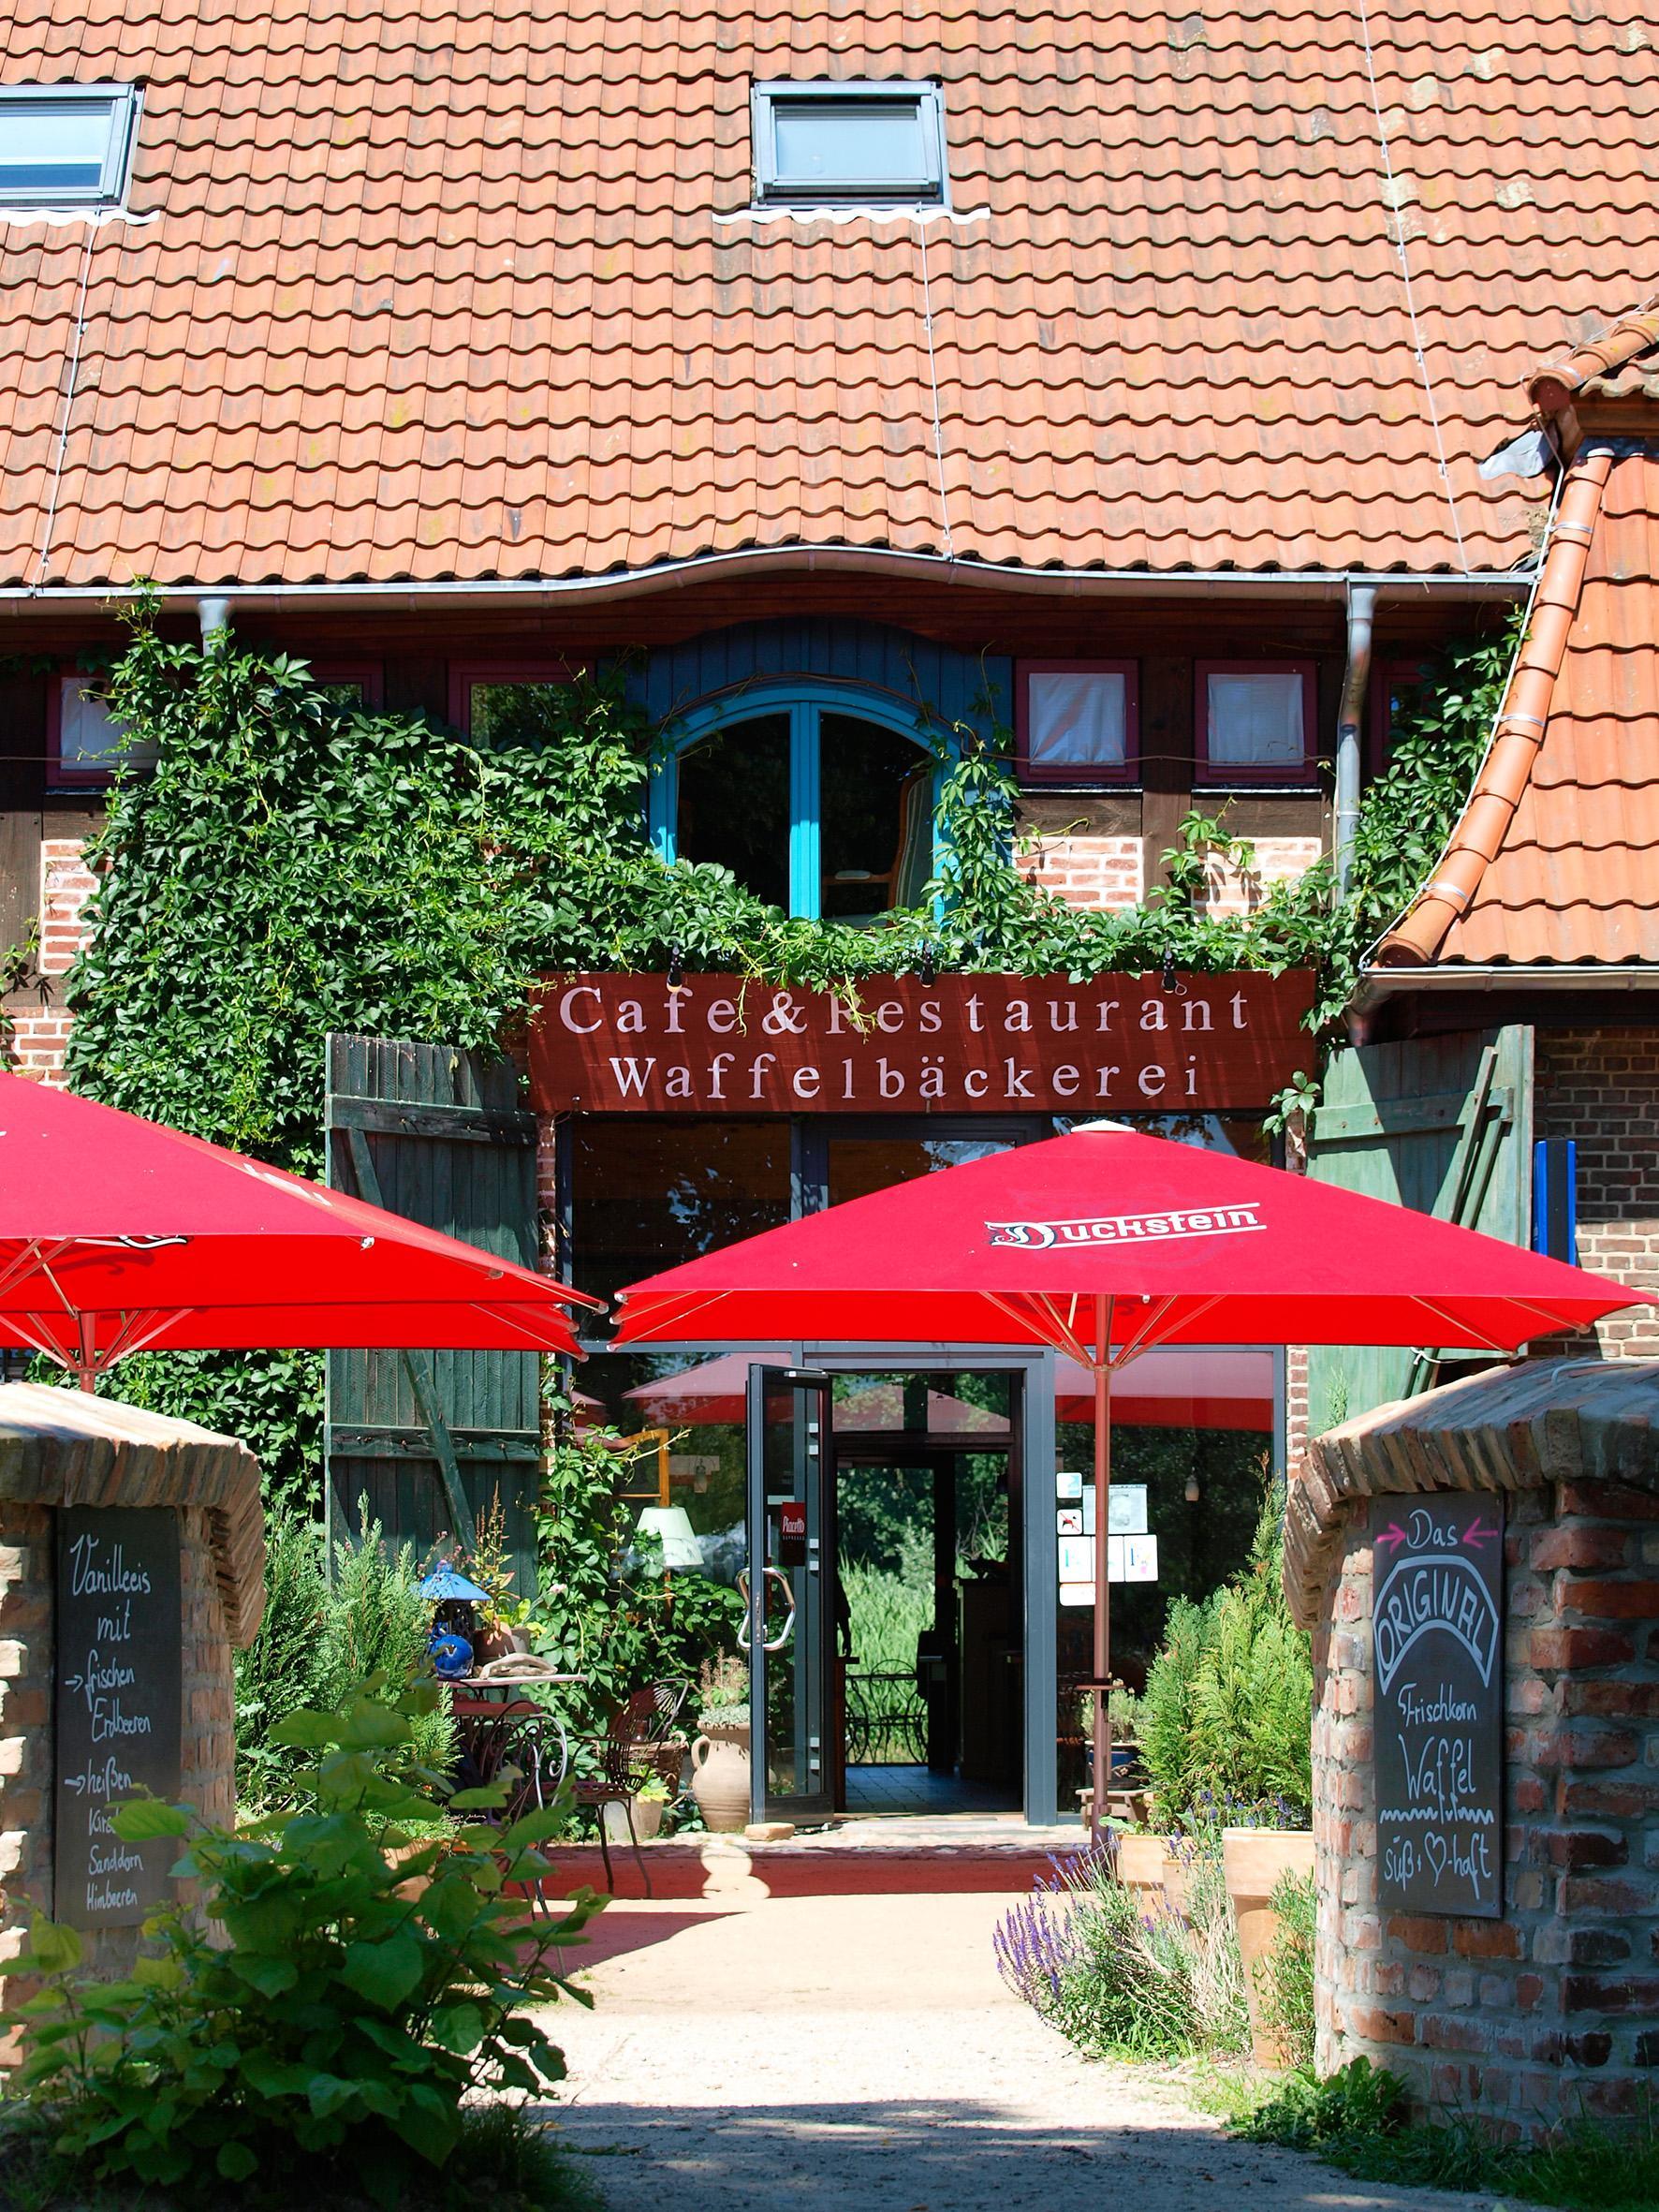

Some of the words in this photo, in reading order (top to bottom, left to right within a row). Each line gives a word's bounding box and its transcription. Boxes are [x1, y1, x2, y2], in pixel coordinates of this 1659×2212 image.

[825, 989, 1249, 1035] Restaurant
[609, 1052, 1199, 1099] Waffelbäckerei
[984, 1207, 1259, 1250] Duckstein
[1406, 1509, 1459, 1550] Das
[69, 1533, 152, 1596] Vanilleeis
[97, 1599, 131, 1642] mit
[1378, 1569, 1485, 1672] ORIGINAL
[85, 1649, 136, 1712] frischen
[91, 1697, 152, 1743] Erdbeeren
[1398, 1682, 1477, 1728] Frischkorn
[87, 1757, 133, 1802] heißen
[1398, 1733, 1476, 1823] Waffel
[88, 1844, 144, 1876] Sanddorn
[86, 1880, 139, 1911] Himbeeren
